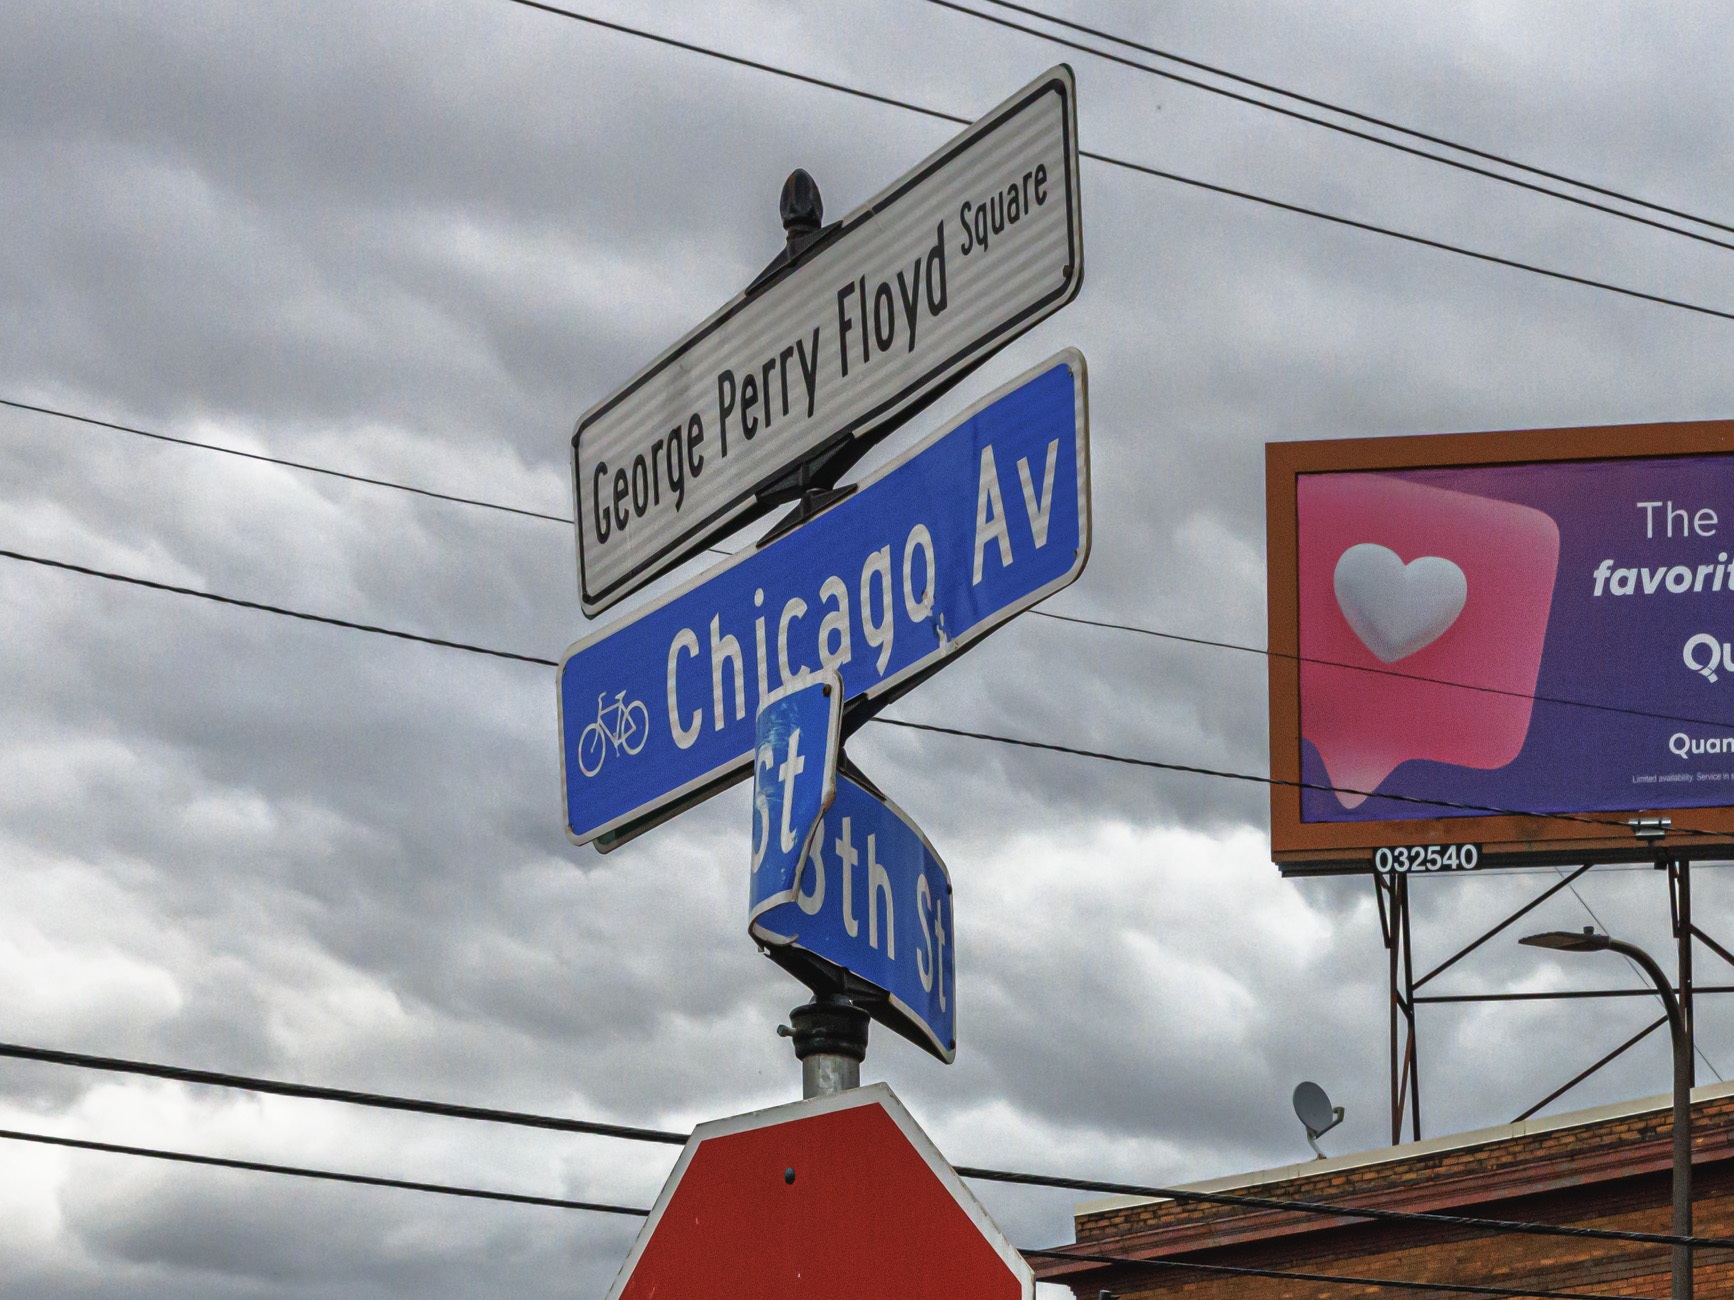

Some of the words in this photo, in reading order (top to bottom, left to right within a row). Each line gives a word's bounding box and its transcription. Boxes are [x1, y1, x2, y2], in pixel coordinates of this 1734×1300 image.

[592, 410, 704, 544] George
[716, 326, 821, 457] Perry
[836, 220, 948, 378] Floyd
[958, 162, 1049, 257] Square
[666, 522, 937, 750] Chicago
[972, 438, 1060, 587] Av
[1636, 500, 1718, 539] The
[797, 809, 896, 961] 8th
[916, 873, 949, 1013] St
[1375, 844, 1478, 873] 032540
